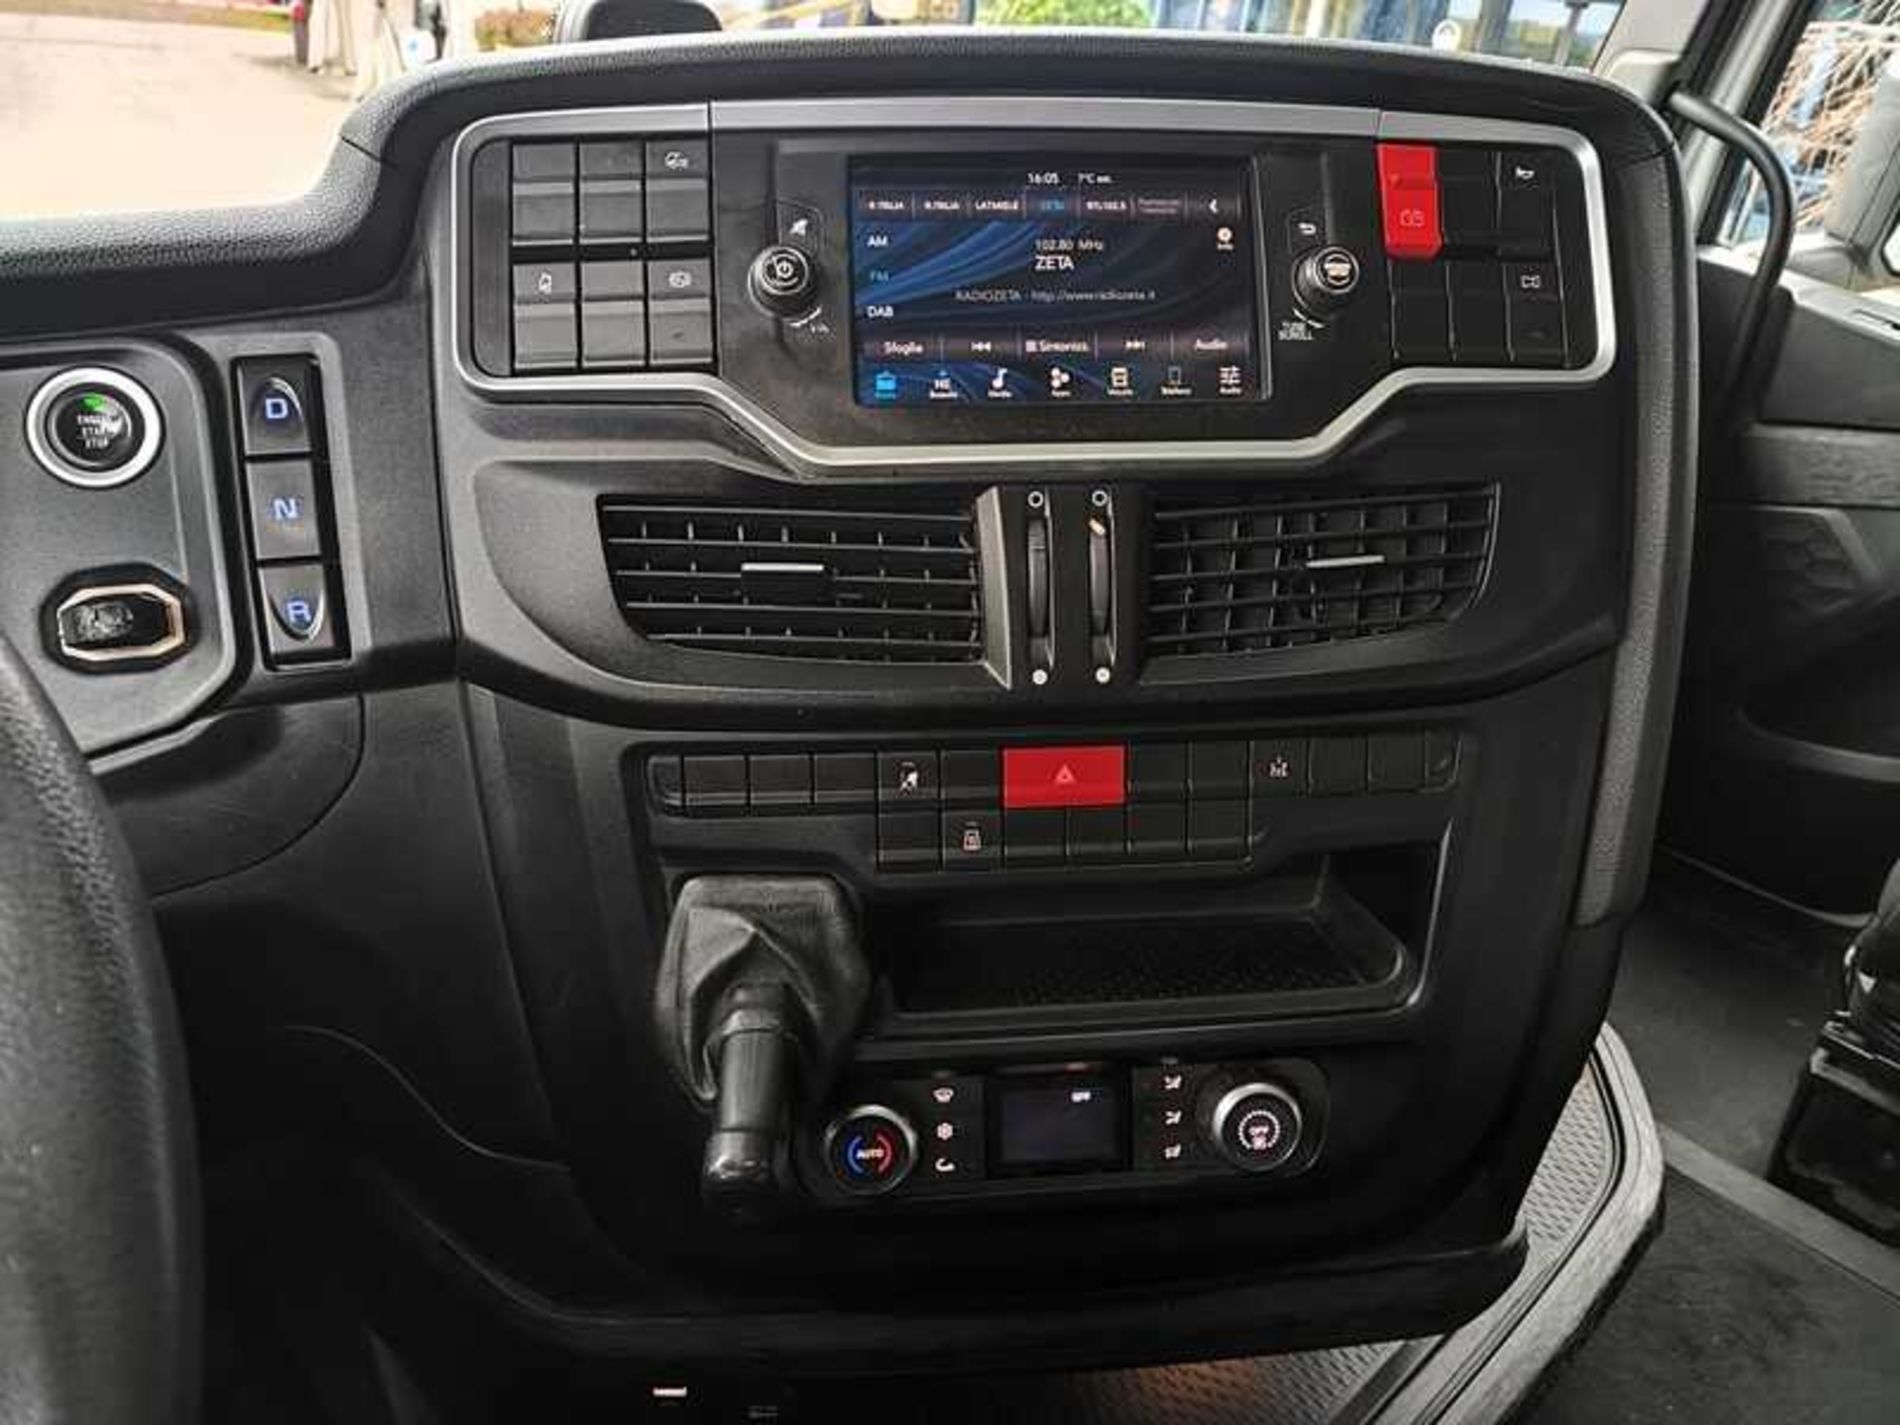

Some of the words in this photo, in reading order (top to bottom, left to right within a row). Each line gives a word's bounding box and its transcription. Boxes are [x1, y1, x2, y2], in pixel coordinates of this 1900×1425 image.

[867, 235, 888, 248] AM
[1034, 254, 1074, 271] ZETA
[866, 306, 894, 318] DAB
[1194, 339, 1229, 351] Audio
[265, 399, 288, 419] D
[273, 498, 299, 520] N
[287, 600, 311, 622] R
